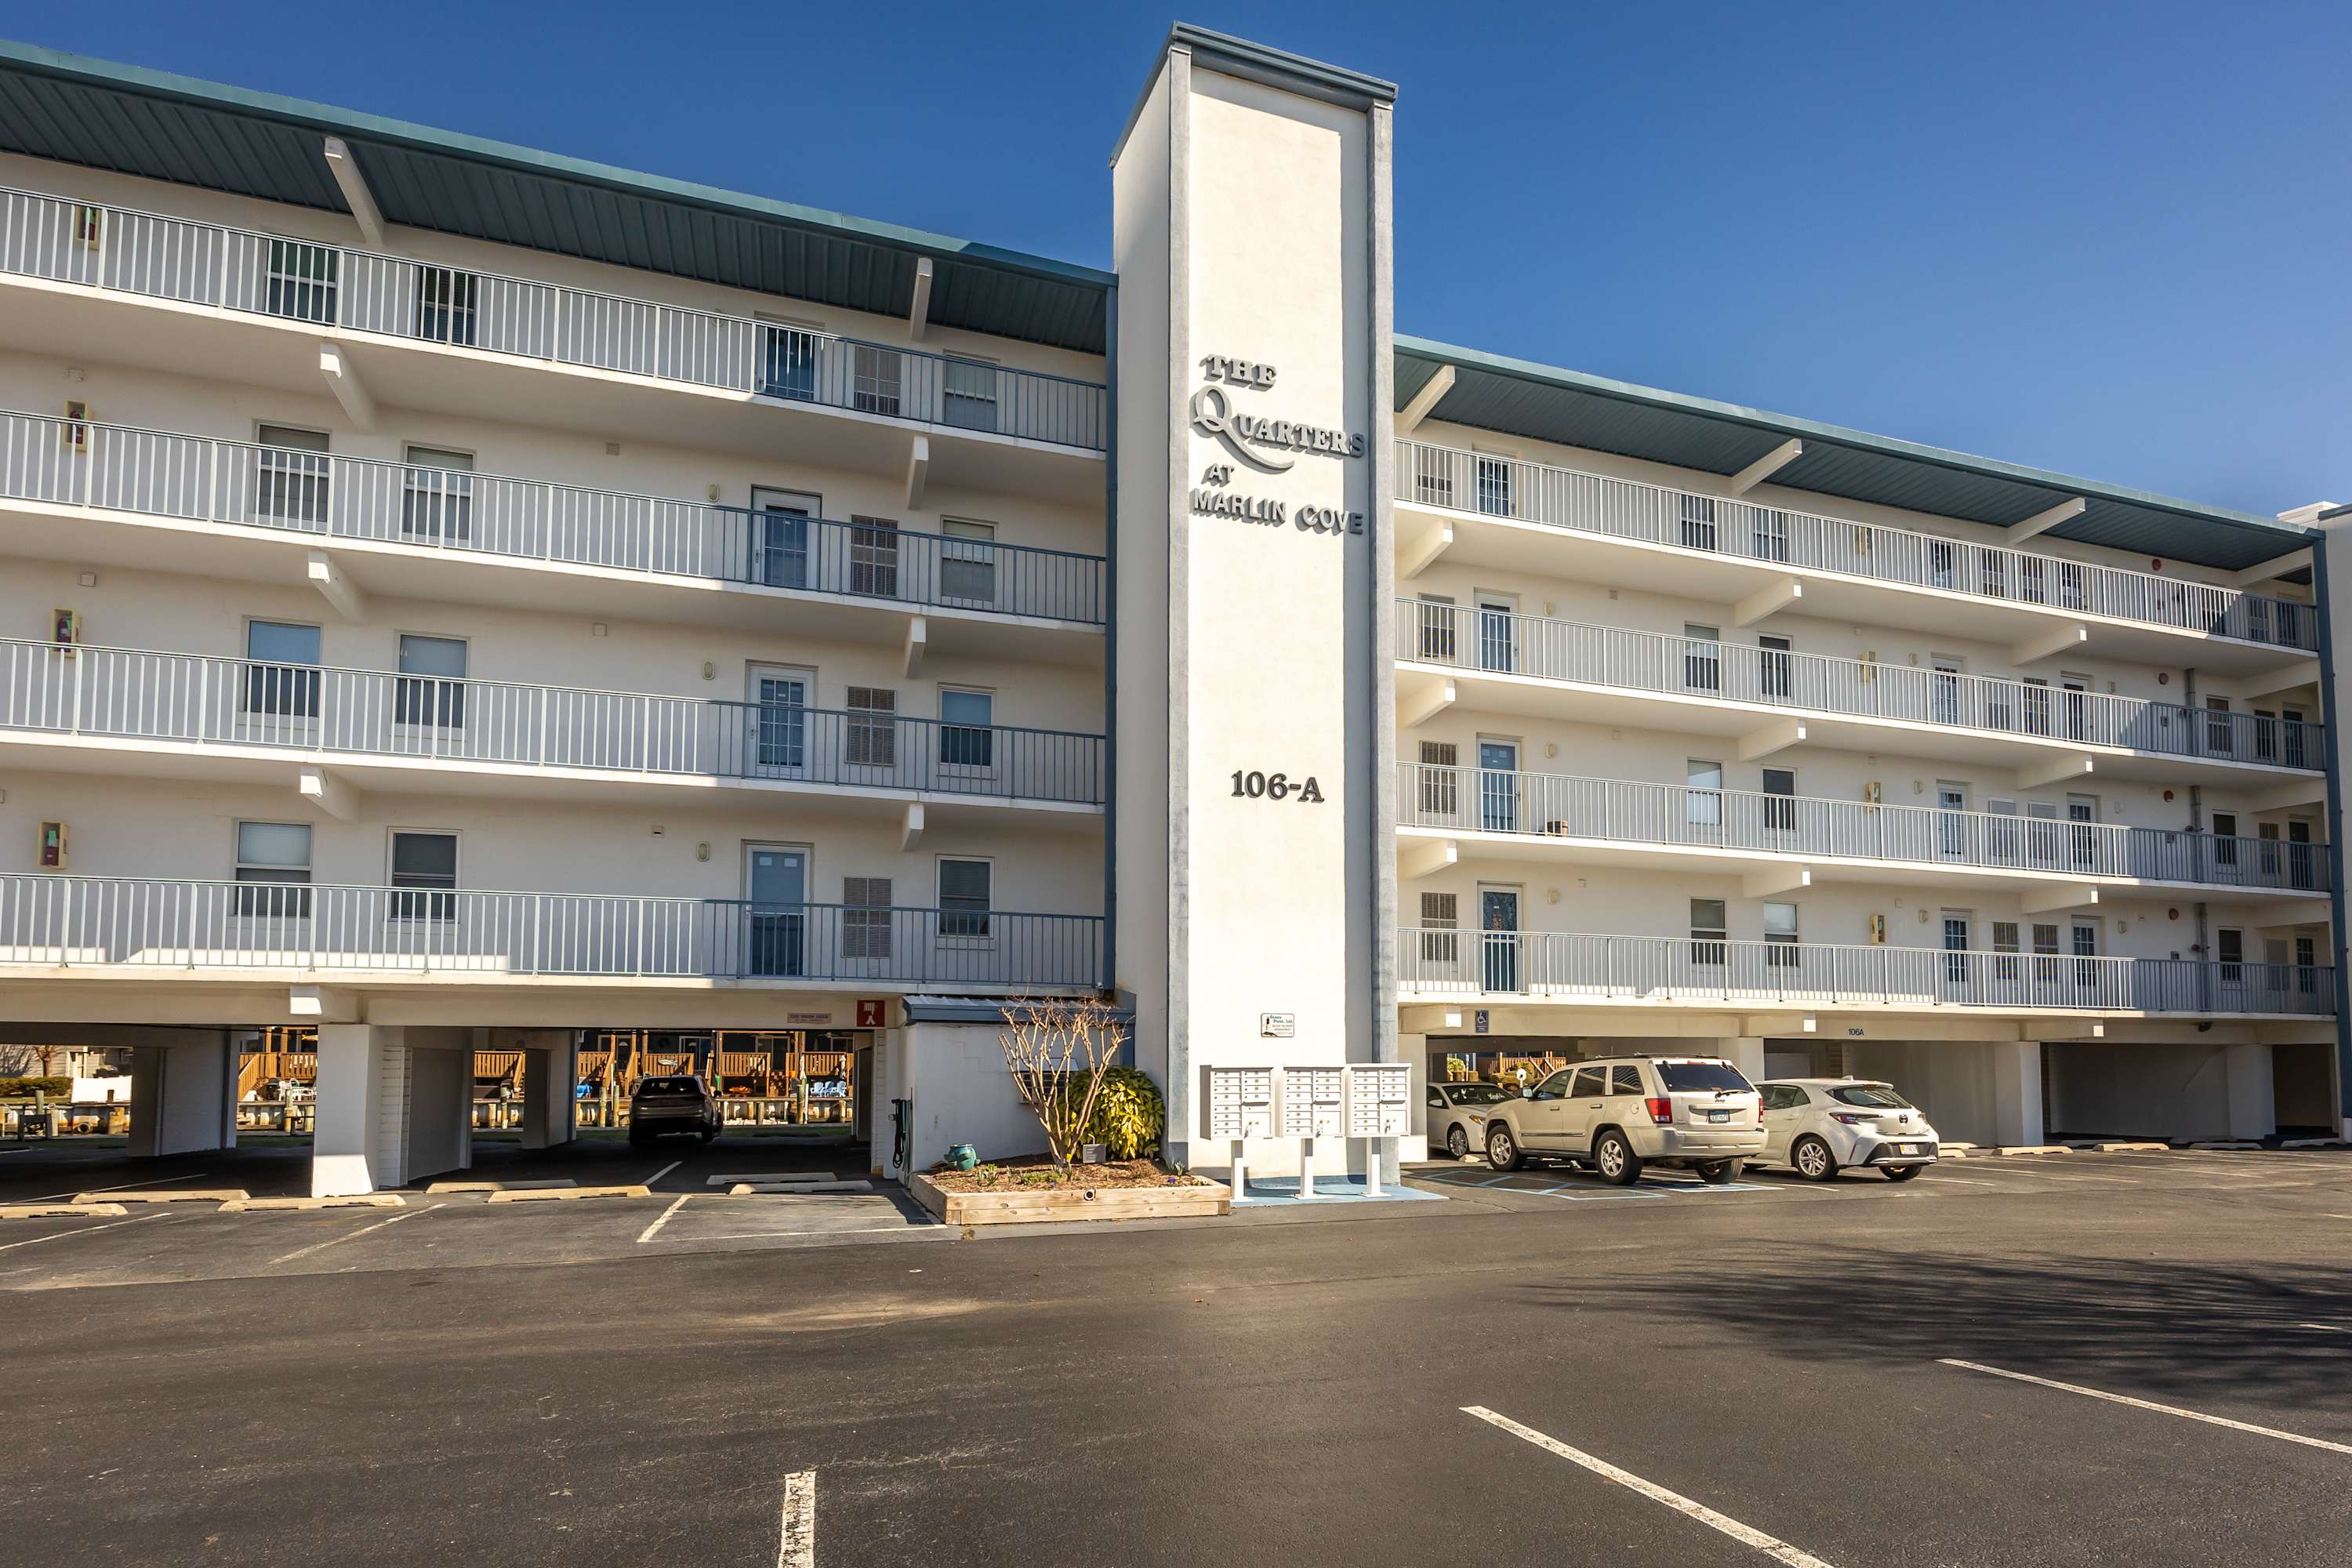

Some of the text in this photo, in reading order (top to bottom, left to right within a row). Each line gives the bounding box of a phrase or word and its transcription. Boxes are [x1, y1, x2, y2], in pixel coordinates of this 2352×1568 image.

[1203, 354, 1277, 387] THE
[1192, 385, 1366, 471] QUARTERS
[1207, 463, 1235, 484] AT
[1192, 488, 1364, 535] MARLIN COVE
[1231, 770, 1325, 803] 106-A
